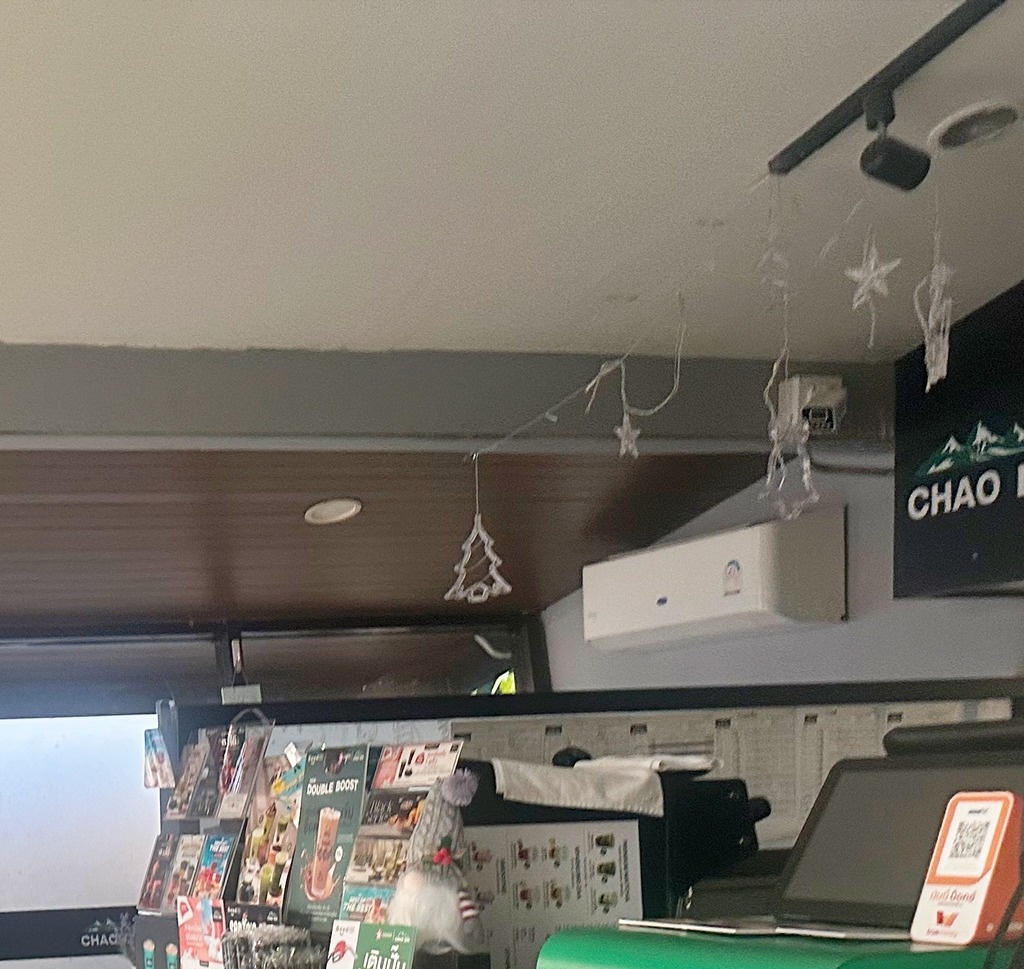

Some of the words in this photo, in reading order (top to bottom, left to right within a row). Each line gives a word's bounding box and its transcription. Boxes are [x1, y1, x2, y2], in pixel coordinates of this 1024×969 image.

[908, 469, 1001, 520] CHAO
[307, 781, 334, 795] DOUBLE
[335, 778, 358, 792] BOOST
[81, 934, 117, 947] CHAO
